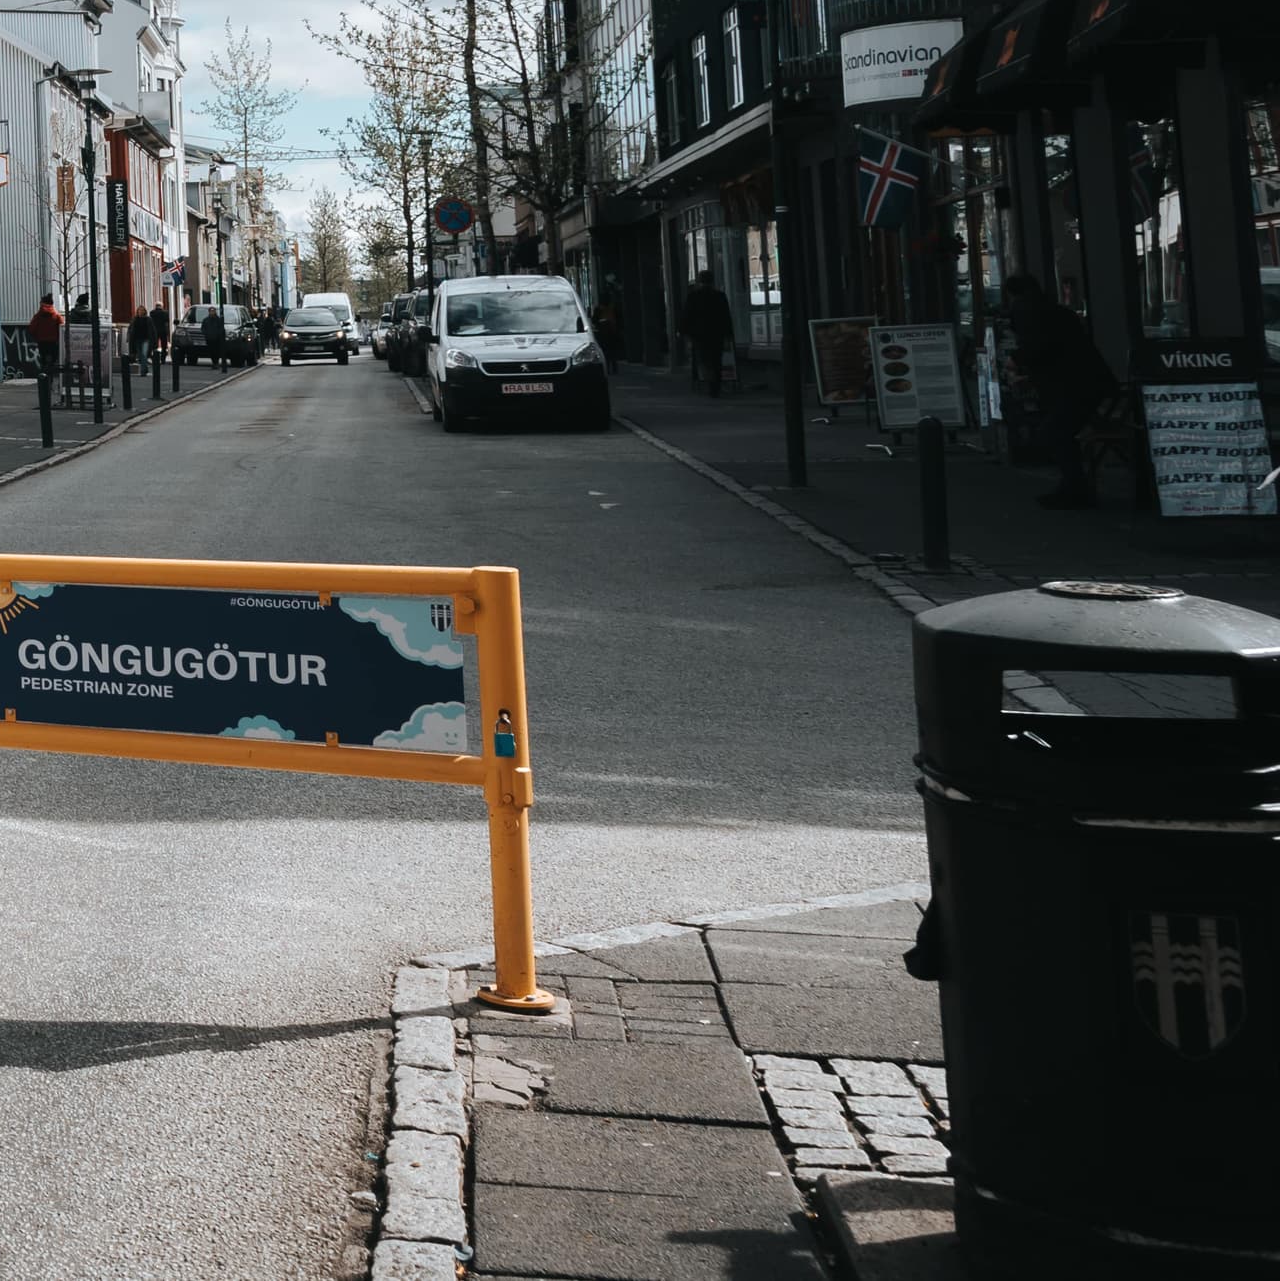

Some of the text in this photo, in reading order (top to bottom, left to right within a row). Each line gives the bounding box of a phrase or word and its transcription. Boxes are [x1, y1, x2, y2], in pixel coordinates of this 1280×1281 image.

[844, 45, 942, 71] Scandinavian
[1144, 392, 1203, 403] HAPPY
[1149, 419, 1265, 431] HAPPY HOUR
[1152, 446, 1271, 457] HAPPY HOUR
[1158, 473, 1214, 484] HAPPY
[230, 597, 325, 611] #GÖNGUGÖTUR
[17, 634, 327, 687] GÖNGUGÖTUR
[21, 675, 174, 699] PEDESTRIAN ZONE
